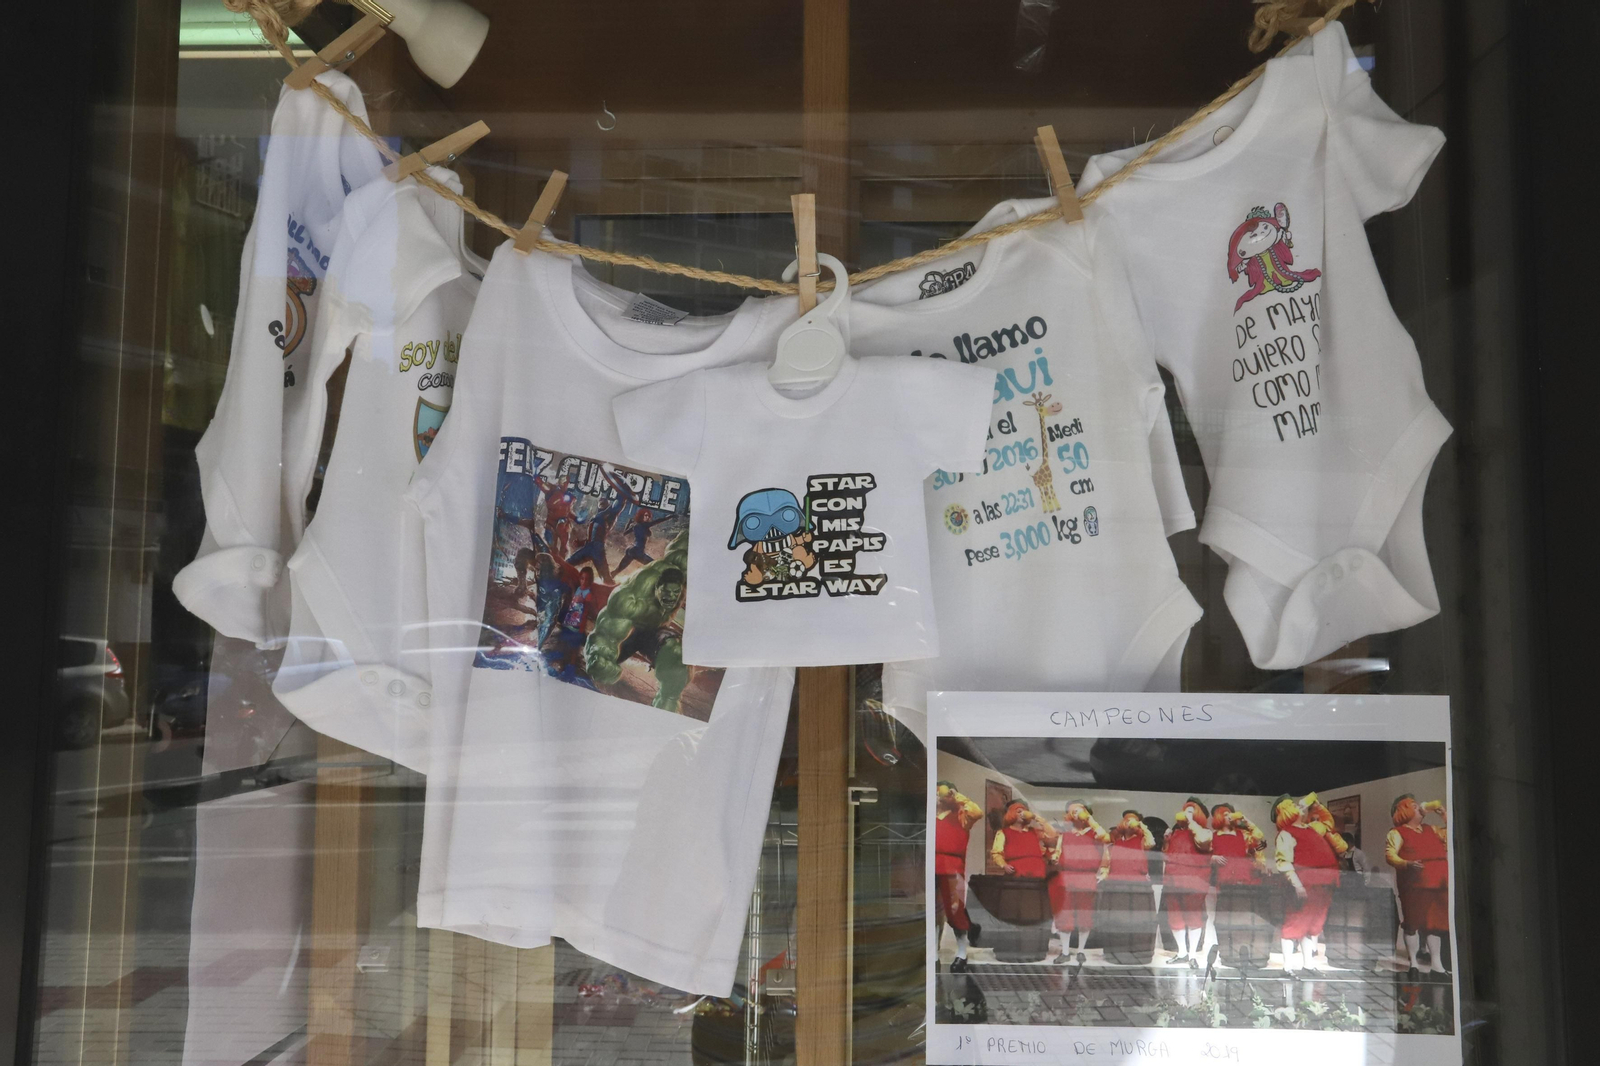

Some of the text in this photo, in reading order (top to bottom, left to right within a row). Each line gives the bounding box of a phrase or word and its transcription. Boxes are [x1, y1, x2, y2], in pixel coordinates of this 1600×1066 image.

[952, 315, 1048, 364] llamo
[1252, 369, 1312, 409] COMO
[996, 410, 1018, 435] el
[1046, 417, 1084, 443] Medi
[1056, 441, 1090, 475] 50
[809, 475, 874, 492] STAR
[1069, 477, 1095, 496] cm
[811, 496, 863, 512] CON
[972, 508, 985, 525] a
[981, 500, 1003, 522] las
[822, 517, 861, 533] MIS
[812, 536, 884, 552] PAPIS
[999, 520, 1052, 562] 3,000
[1051, 514, 1082, 545] kg
[823, 558, 853, 574] ES
[739, 578, 884, 598] ESTAR WAY
[1049, 703, 1214, 728] CAMPEONES
[986, 1036, 1047, 1054] PREMIO
[1073, 1040, 1096, 1056] DE
[1109, 1038, 1170, 1058] MURGA
[1200, 1041, 1240, 1063] 2019
